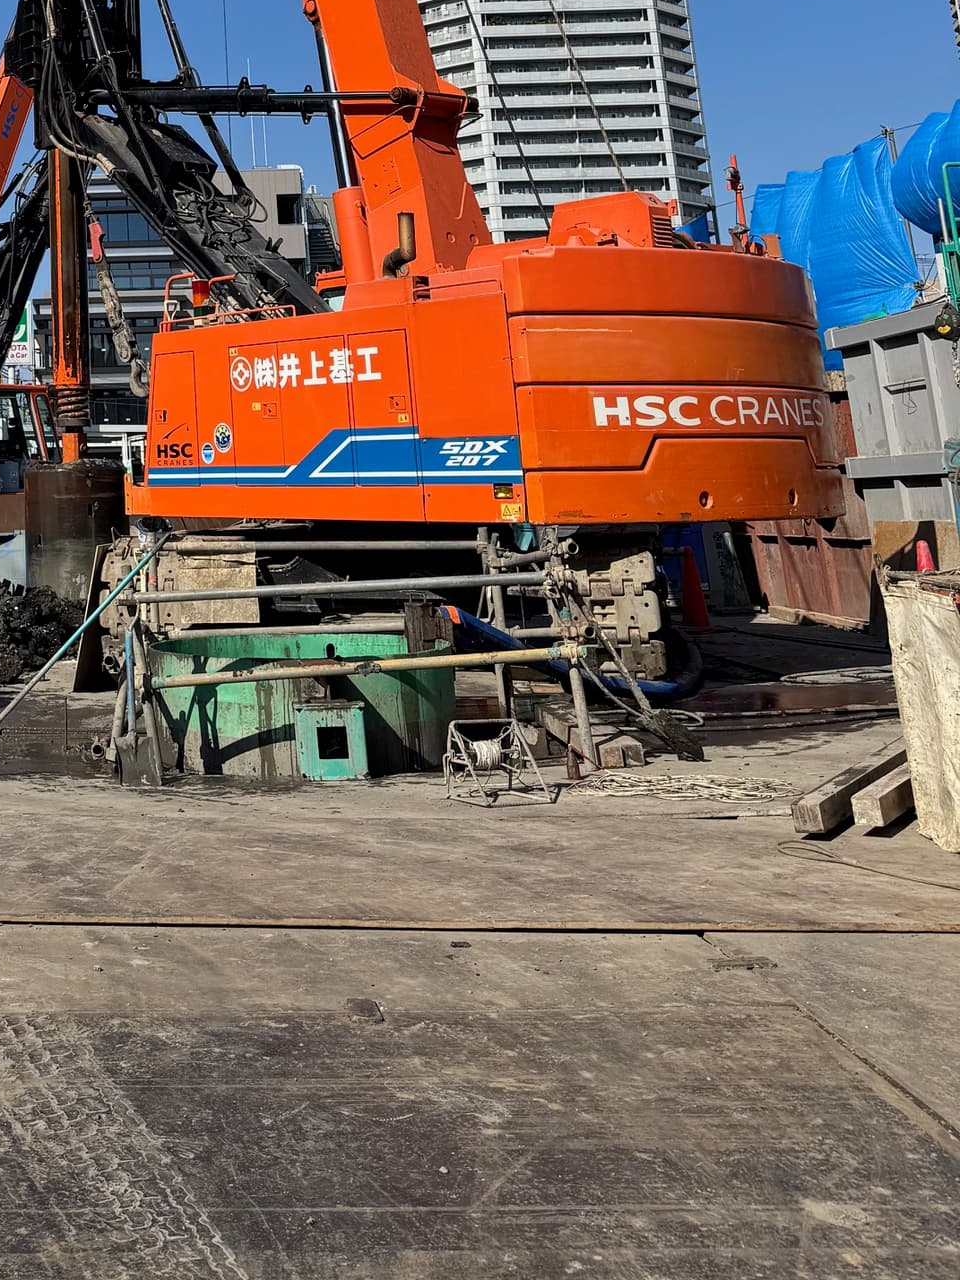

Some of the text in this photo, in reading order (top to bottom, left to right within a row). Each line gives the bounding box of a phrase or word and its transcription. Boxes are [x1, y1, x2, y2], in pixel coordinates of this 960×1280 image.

[592, 395, 824, 427] HSC CRANES
[156, 442, 194, 458] HSC
[439, 440, 510, 455] SDX
[444, 454, 500, 467] 207
